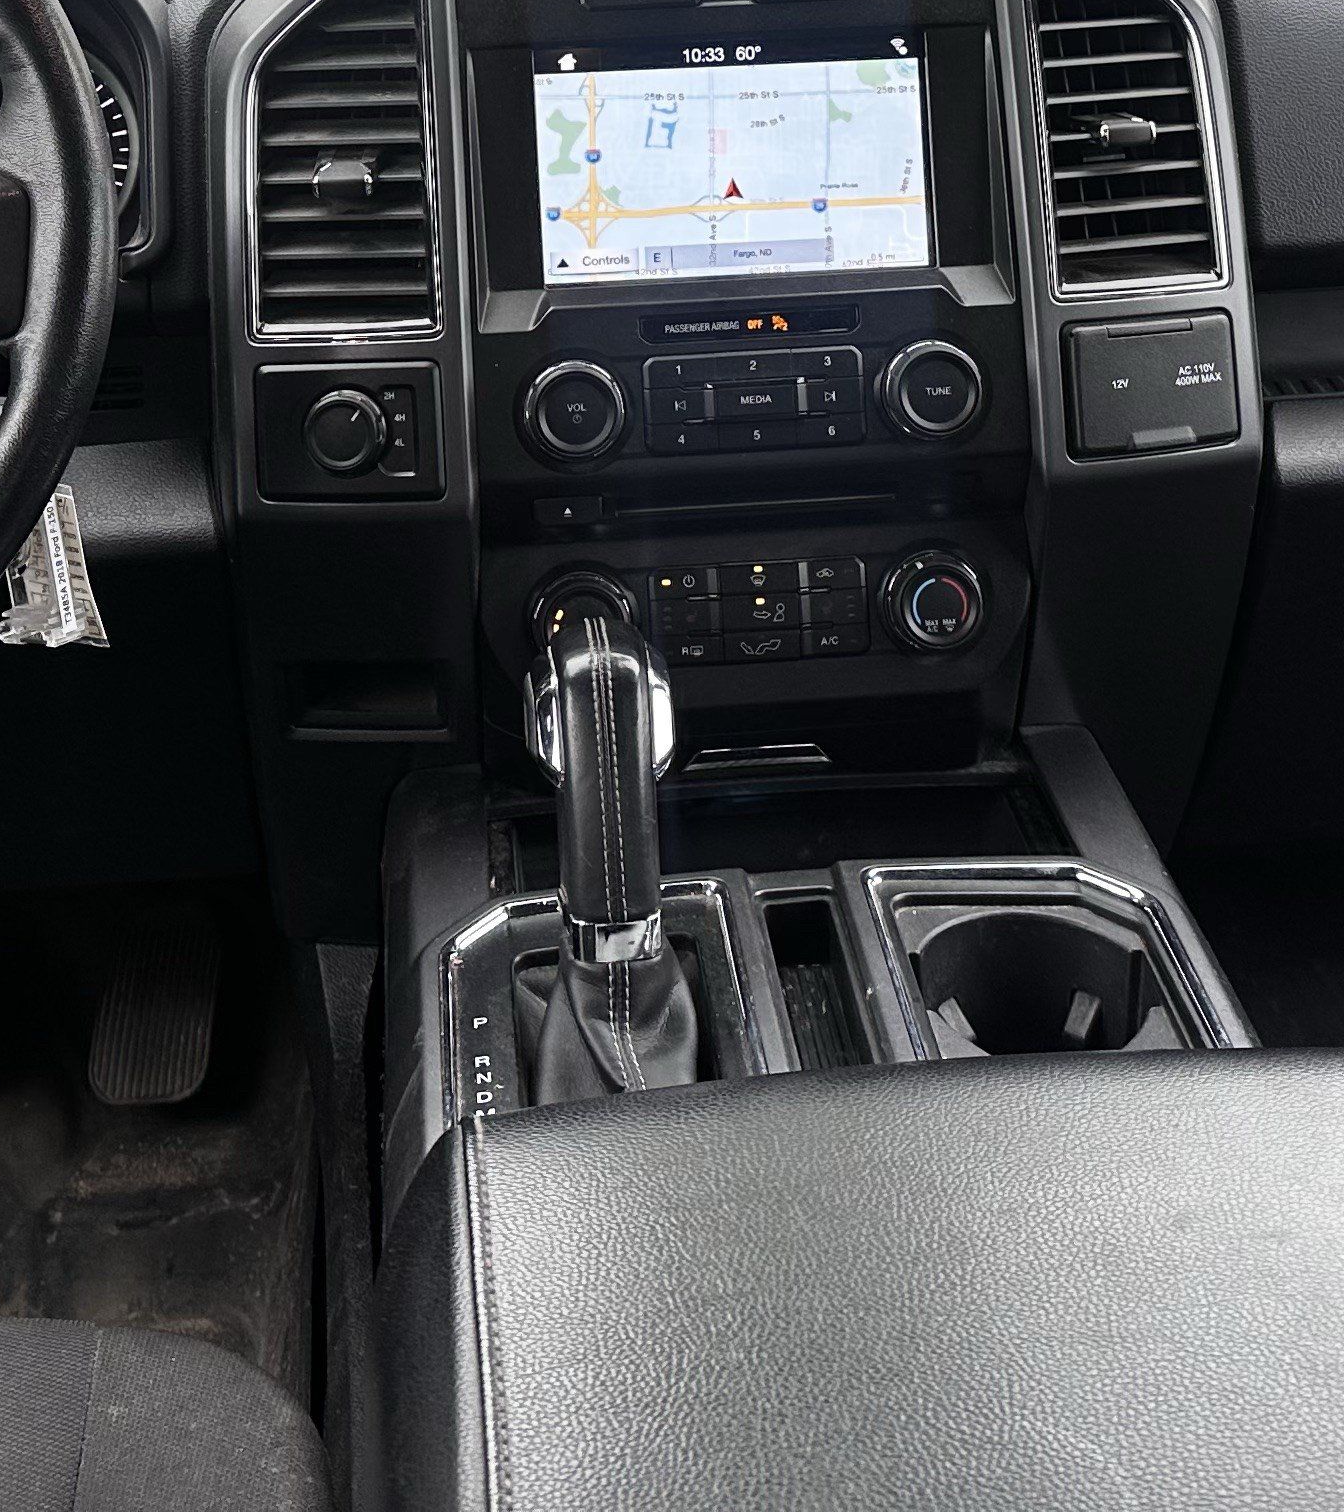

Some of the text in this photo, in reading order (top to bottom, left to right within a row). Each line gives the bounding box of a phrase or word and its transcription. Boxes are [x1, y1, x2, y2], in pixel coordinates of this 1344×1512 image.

[683, 45, 762, 63] 10:33 60°
[739, 92, 758, 100] 25th
[761, 91, 771, 99] St
[876, 86, 896, 94] 25th
[582, 254, 630, 267] Controls
[654, 252, 661, 263] E
[664, 322, 711, 334] PASSENGER
[749, 360, 757, 370] 2
[824, 356, 832, 366] 3
[676, 365, 682, 375] 1
[1178, 365, 1192, 376] AC
[1200, 372, 1222, 383] MAX
[1112, 378, 1129, 389] 12V
[925, 386, 952, 396] TUNE
[740, 394, 772, 405] MEDIA
[566, 402, 587, 413] VOL
[754, 429, 760, 440] 5
[828, 425, 835, 436] 6
[678, 434, 685, 445] 4
[51, 536, 61, 559] Ford
[821, 636, 839, 646] A/C
[473, 1016, 489, 1030] P
[474, 1055, 491, 1068] R
[476, 1072, 493, 1085] N
[476, 1091, 494, 1104] D
